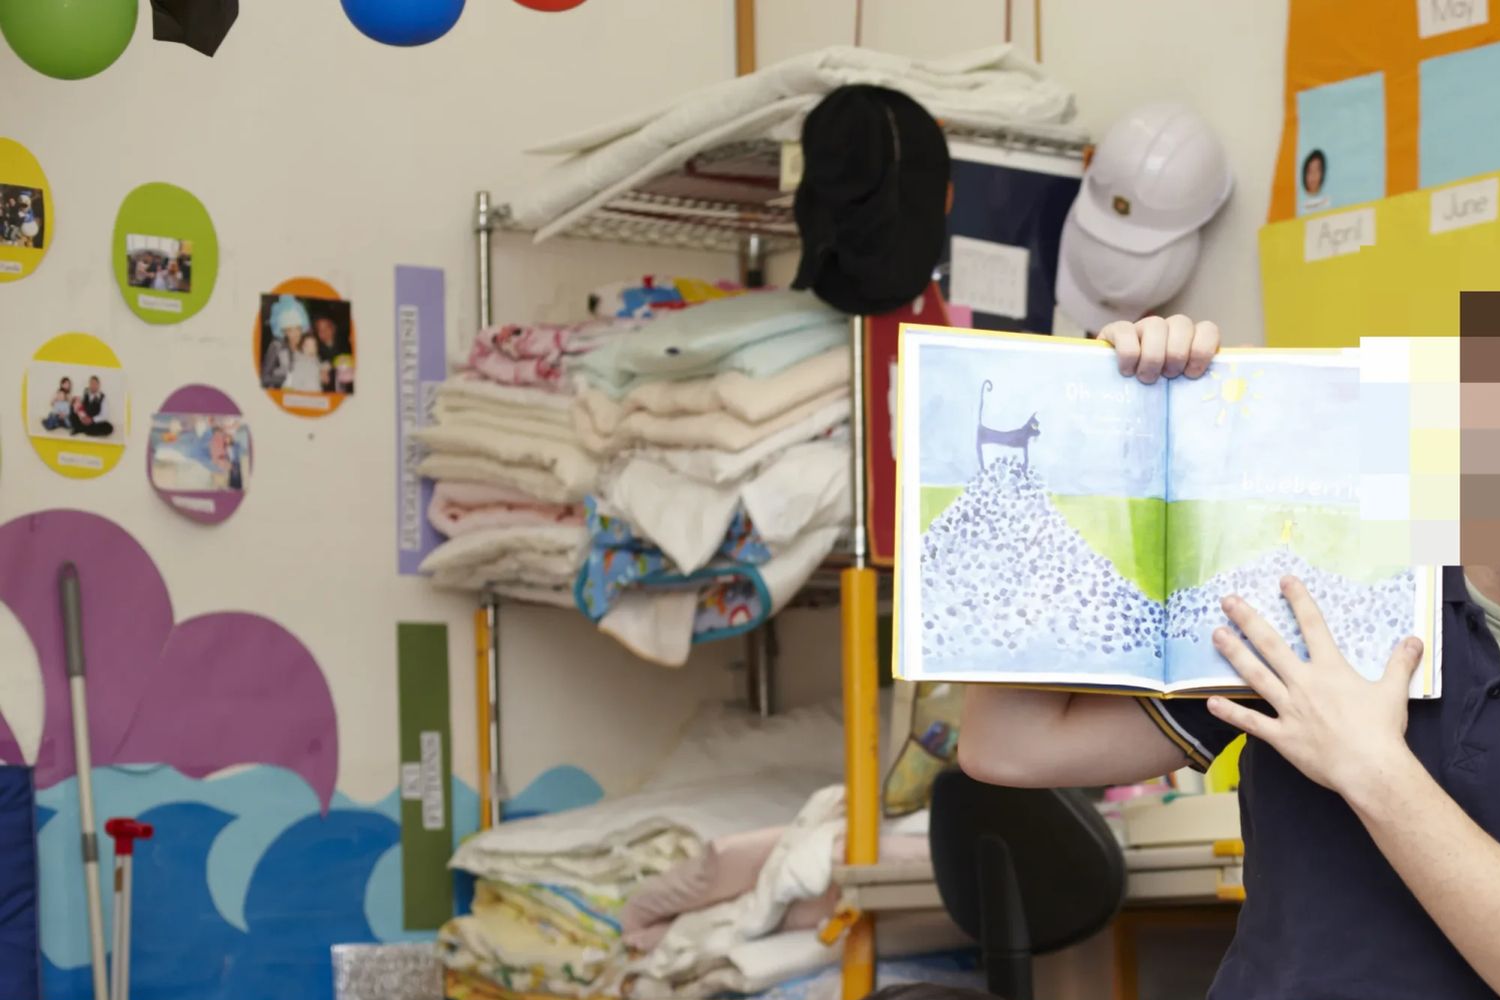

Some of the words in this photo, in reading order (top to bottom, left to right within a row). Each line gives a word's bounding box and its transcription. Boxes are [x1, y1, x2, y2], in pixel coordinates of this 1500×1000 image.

[1431, 0, 1473, 23] May
[1442, 191, 1489, 222] June
[1316, 213, 1364, 253] April
